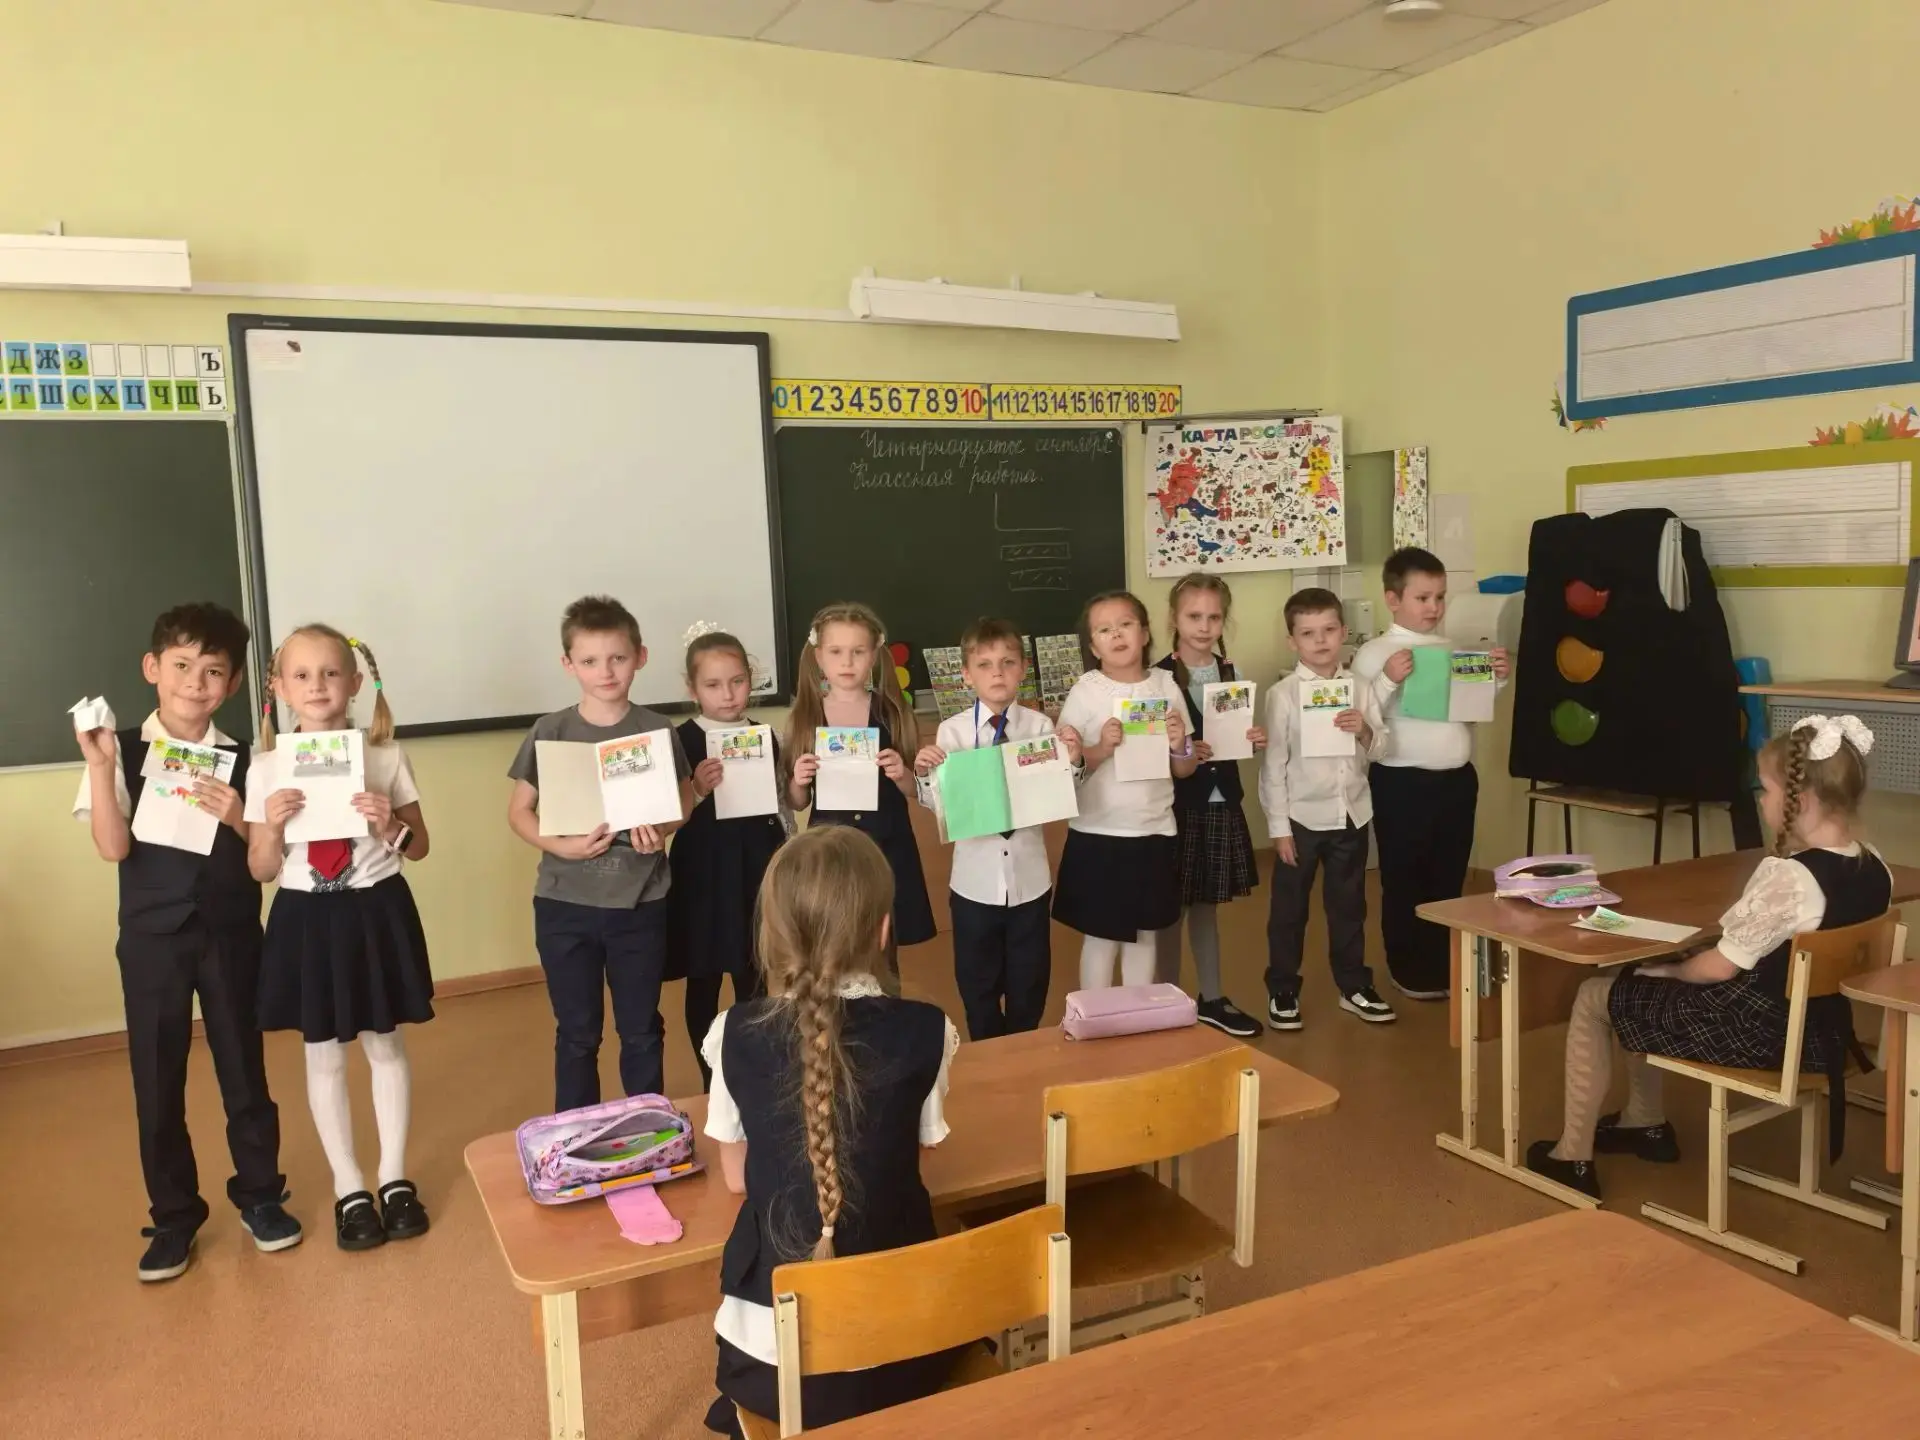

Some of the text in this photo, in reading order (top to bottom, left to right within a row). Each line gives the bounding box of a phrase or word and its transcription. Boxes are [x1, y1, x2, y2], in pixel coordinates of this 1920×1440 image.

[10, 348, 220, 373] Д Ж З Ъ
[14, 384, 31, 404] Т
[39, 385, 64, 404] Ш
[72, 385, 88, 405] С
[98, 385, 118, 405] Х
[125, 385, 145, 408] Ц
[152, 386, 170, 405] Ч
[177, 386, 200, 407] Щ
[207, 386, 222, 405] Ь
[774, 385, 982, 413] 0 1 2 3 4 5 6 7 8 9 10
[996, 391, 1175, 413] 11 12 13 14 15 16 17 18 19 20
[1181, 428, 1238, 443] КАРТА
